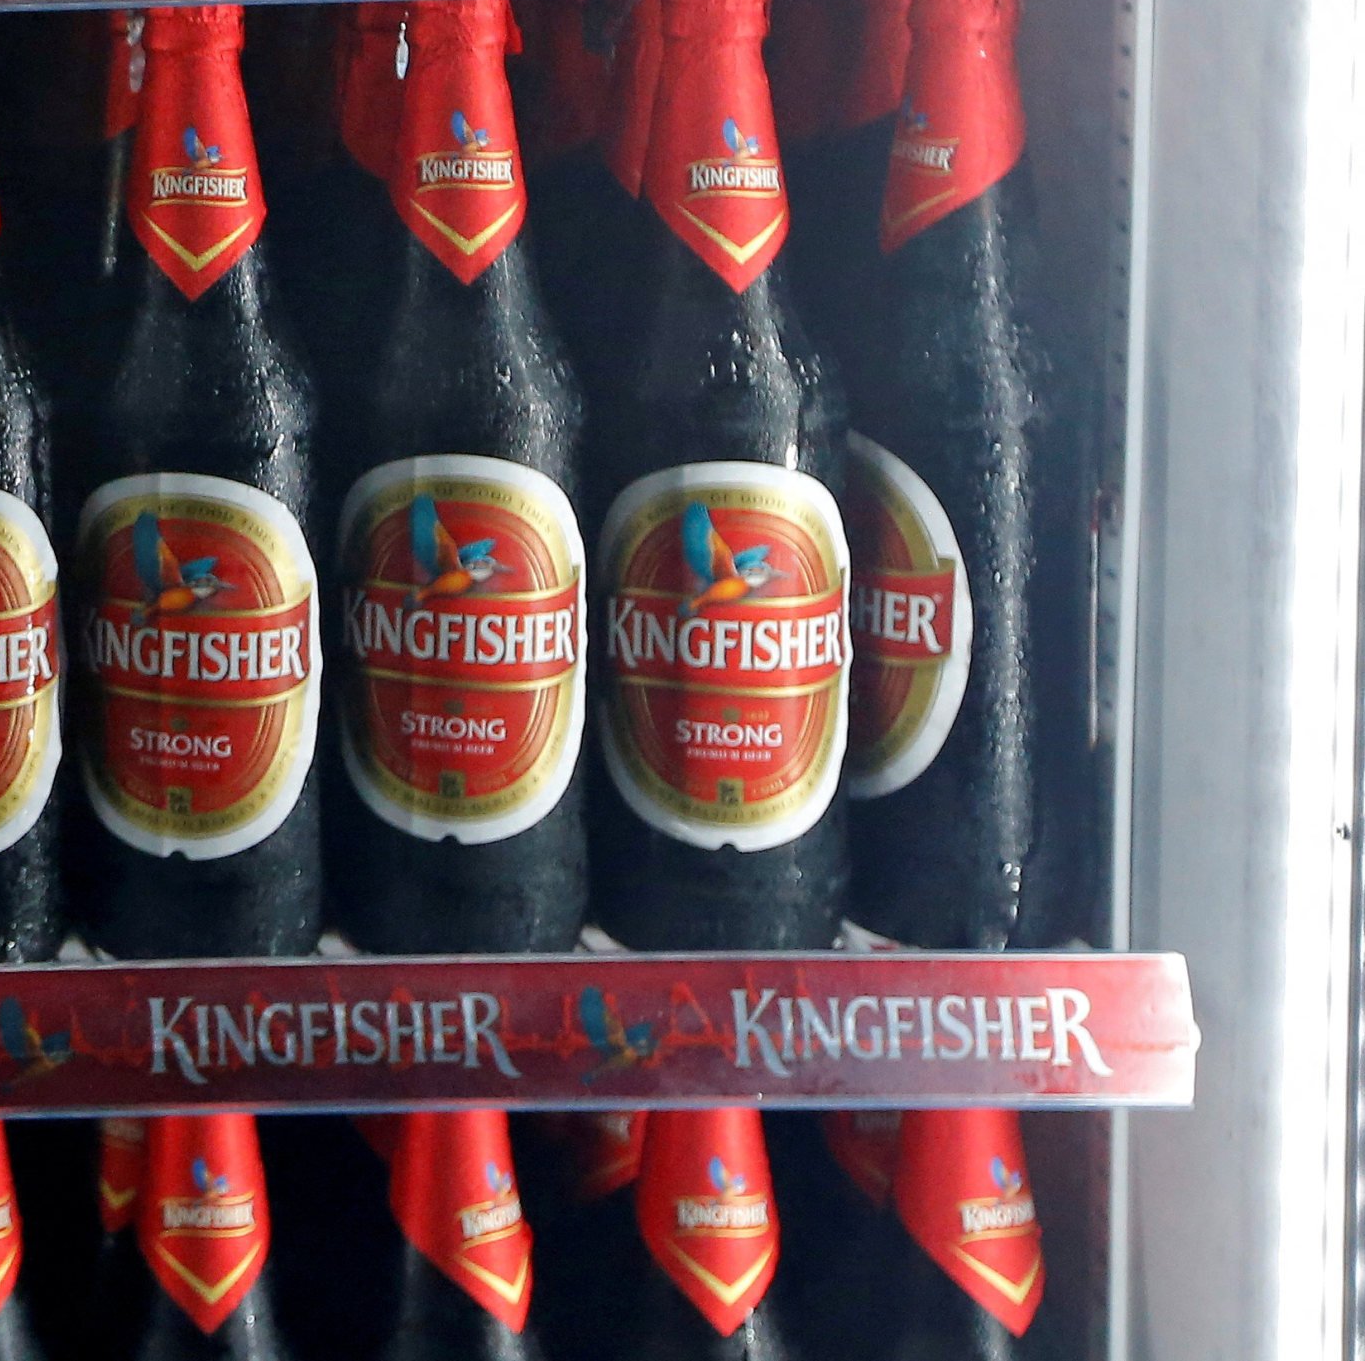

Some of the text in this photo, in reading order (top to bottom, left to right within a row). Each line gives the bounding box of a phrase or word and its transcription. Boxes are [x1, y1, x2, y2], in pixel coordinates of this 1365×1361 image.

[153, 172, 247, 201] KINGFISHER
[420, 157, 513, 185] KINGFISHER
[691, 163, 780, 192] KINGFISHER
[344, 588, 577, 664] KINGFISHER
[607, 598, 845, 672] KINGFISHER
[85, 607, 309, 682] KINGFISHER
[401, 712, 507, 741] STRONG
[675, 719, 783, 747] STRONG
[130, 727, 232, 758] STRONG
[148, 992, 523, 1085] KINGFISHER
[731, 988, 1115, 1078] KINGFISHER
